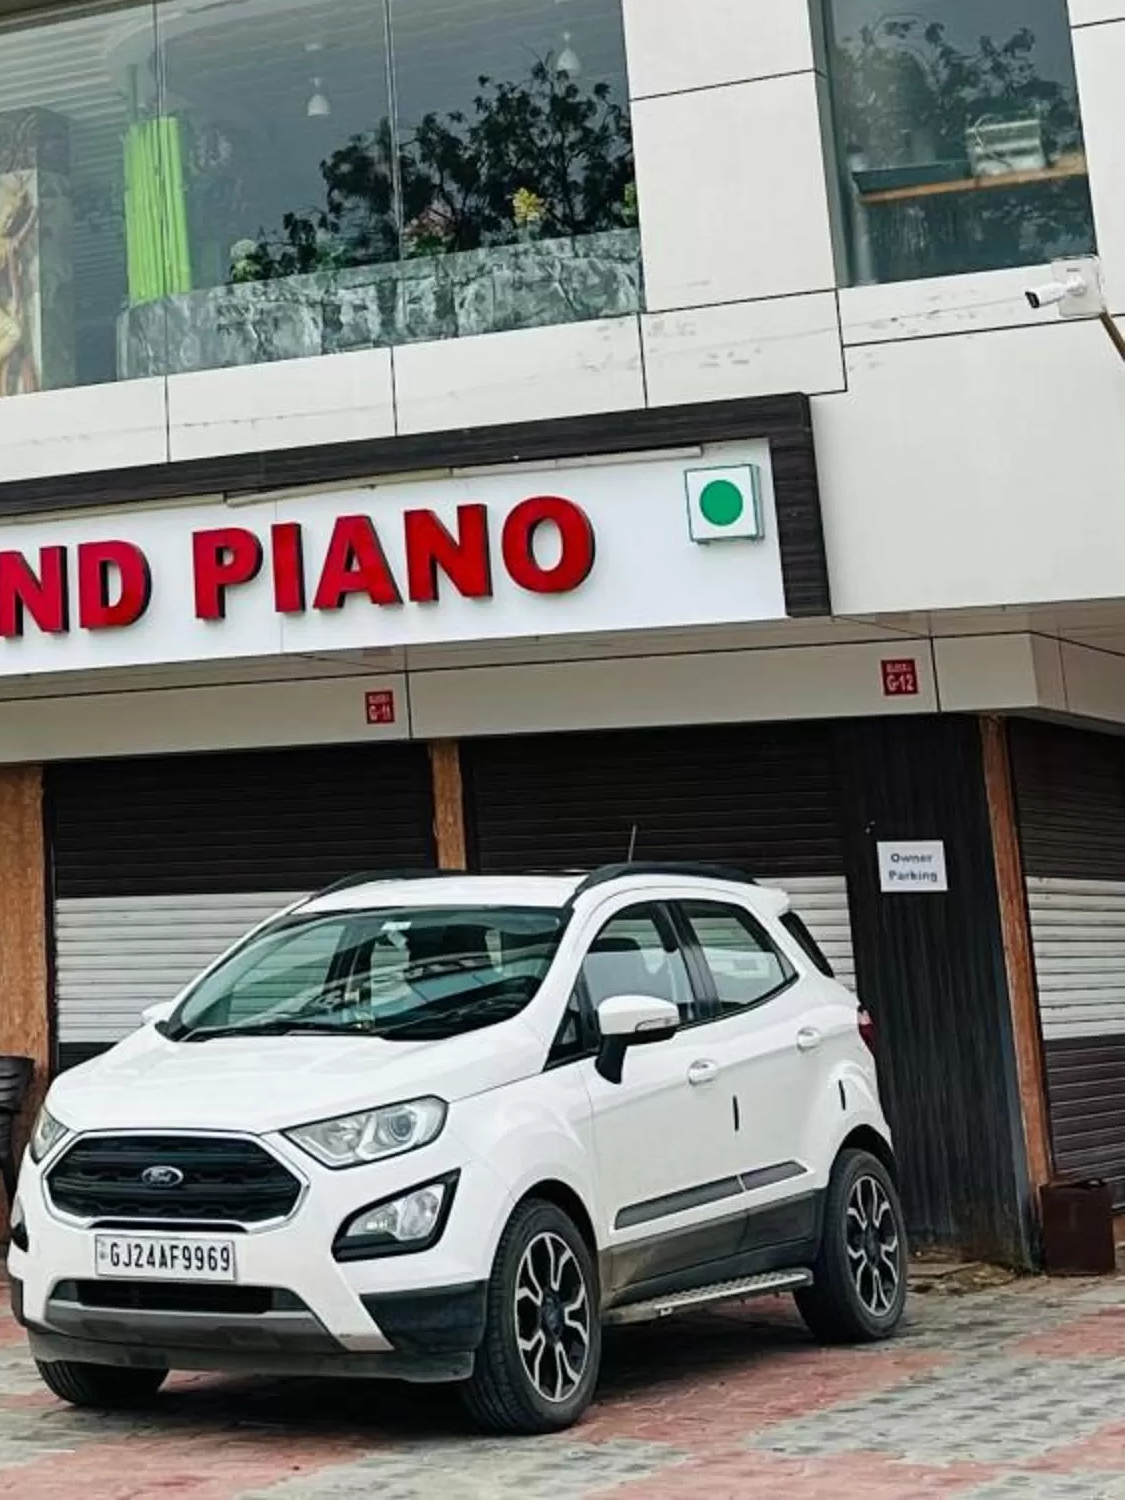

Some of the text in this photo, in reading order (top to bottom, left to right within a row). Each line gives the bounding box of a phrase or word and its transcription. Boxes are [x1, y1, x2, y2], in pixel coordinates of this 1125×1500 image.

[193, 495, 597, 620] PIANO
[891, 853, 932, 863] Owner
[889, 869, 938, 882] Parking
[110, 1242, 230, 1271] GJ24AF9969
